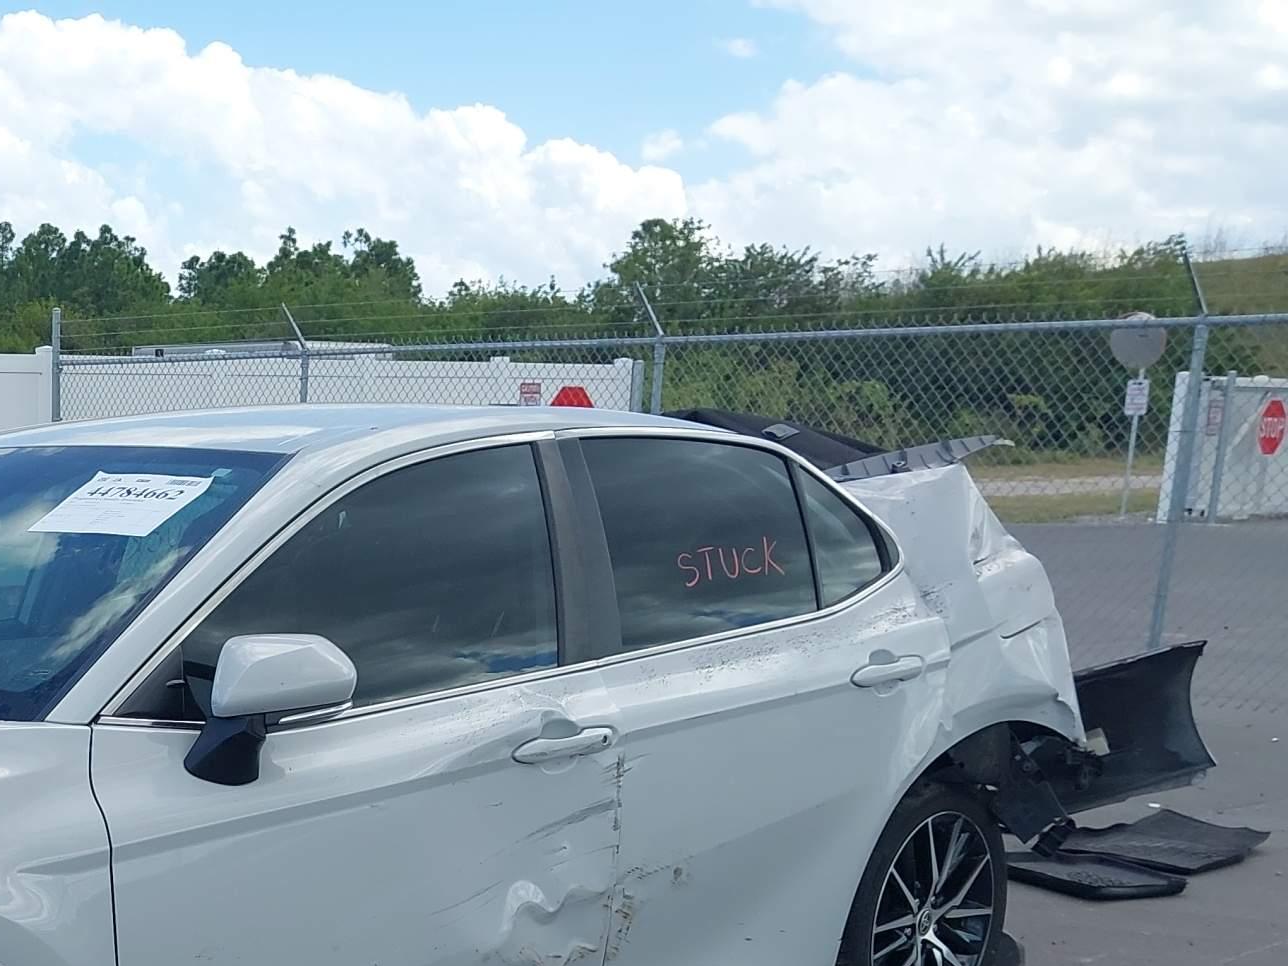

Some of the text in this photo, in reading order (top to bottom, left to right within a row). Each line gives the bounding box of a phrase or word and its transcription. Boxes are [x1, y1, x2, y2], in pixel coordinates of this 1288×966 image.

[1260, 417, 1285, 438] STOP
[87, 486, 185, 500] 44784662
[677, 536, 785, 587] STUCK
